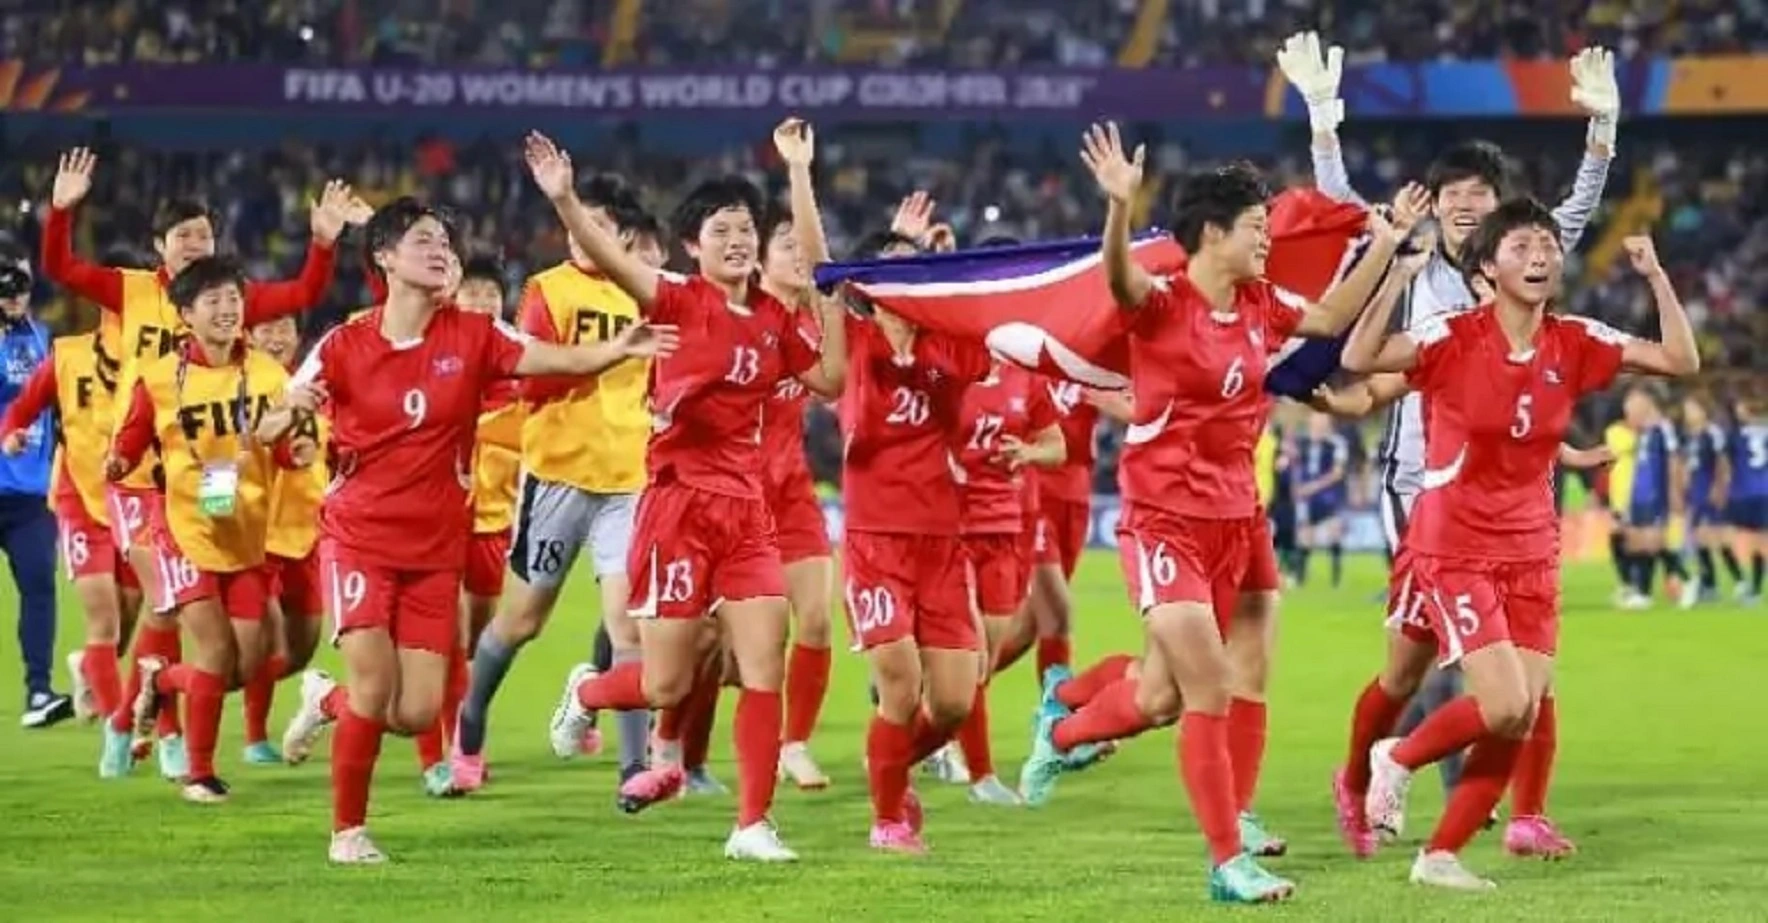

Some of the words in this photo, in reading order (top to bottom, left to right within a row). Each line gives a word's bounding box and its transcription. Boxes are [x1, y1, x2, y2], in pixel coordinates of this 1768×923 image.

[284, 69, 366, 102] FIFA
[373, 70, 454, 105] U-20
[459, 71, 634, 108] WOMEN'S
[640, 73, 772, 108] WORLD
[778, 73, 854, 108] CUP
[574, 309, 635, 344] FIF
[724, 345, 760, 385] 13
[1220, 357, 1244, 398] 6
[402, 387, 428, 430] 9
[886, 386, 930, 426] 20
[1509, 394, 1533, 439] 5
[965, 413, 1004, 451] 17
[169, 555, 200, 594] 16
[530, 539, 565, 573] 18
[1153, 543, 1176, 587] 6
[343, 570, 367, 610] 9
[659, 558, 694, 603] 13
[857, 586, 895, 632] 20
[1456, 594, 1480, 637] 5
